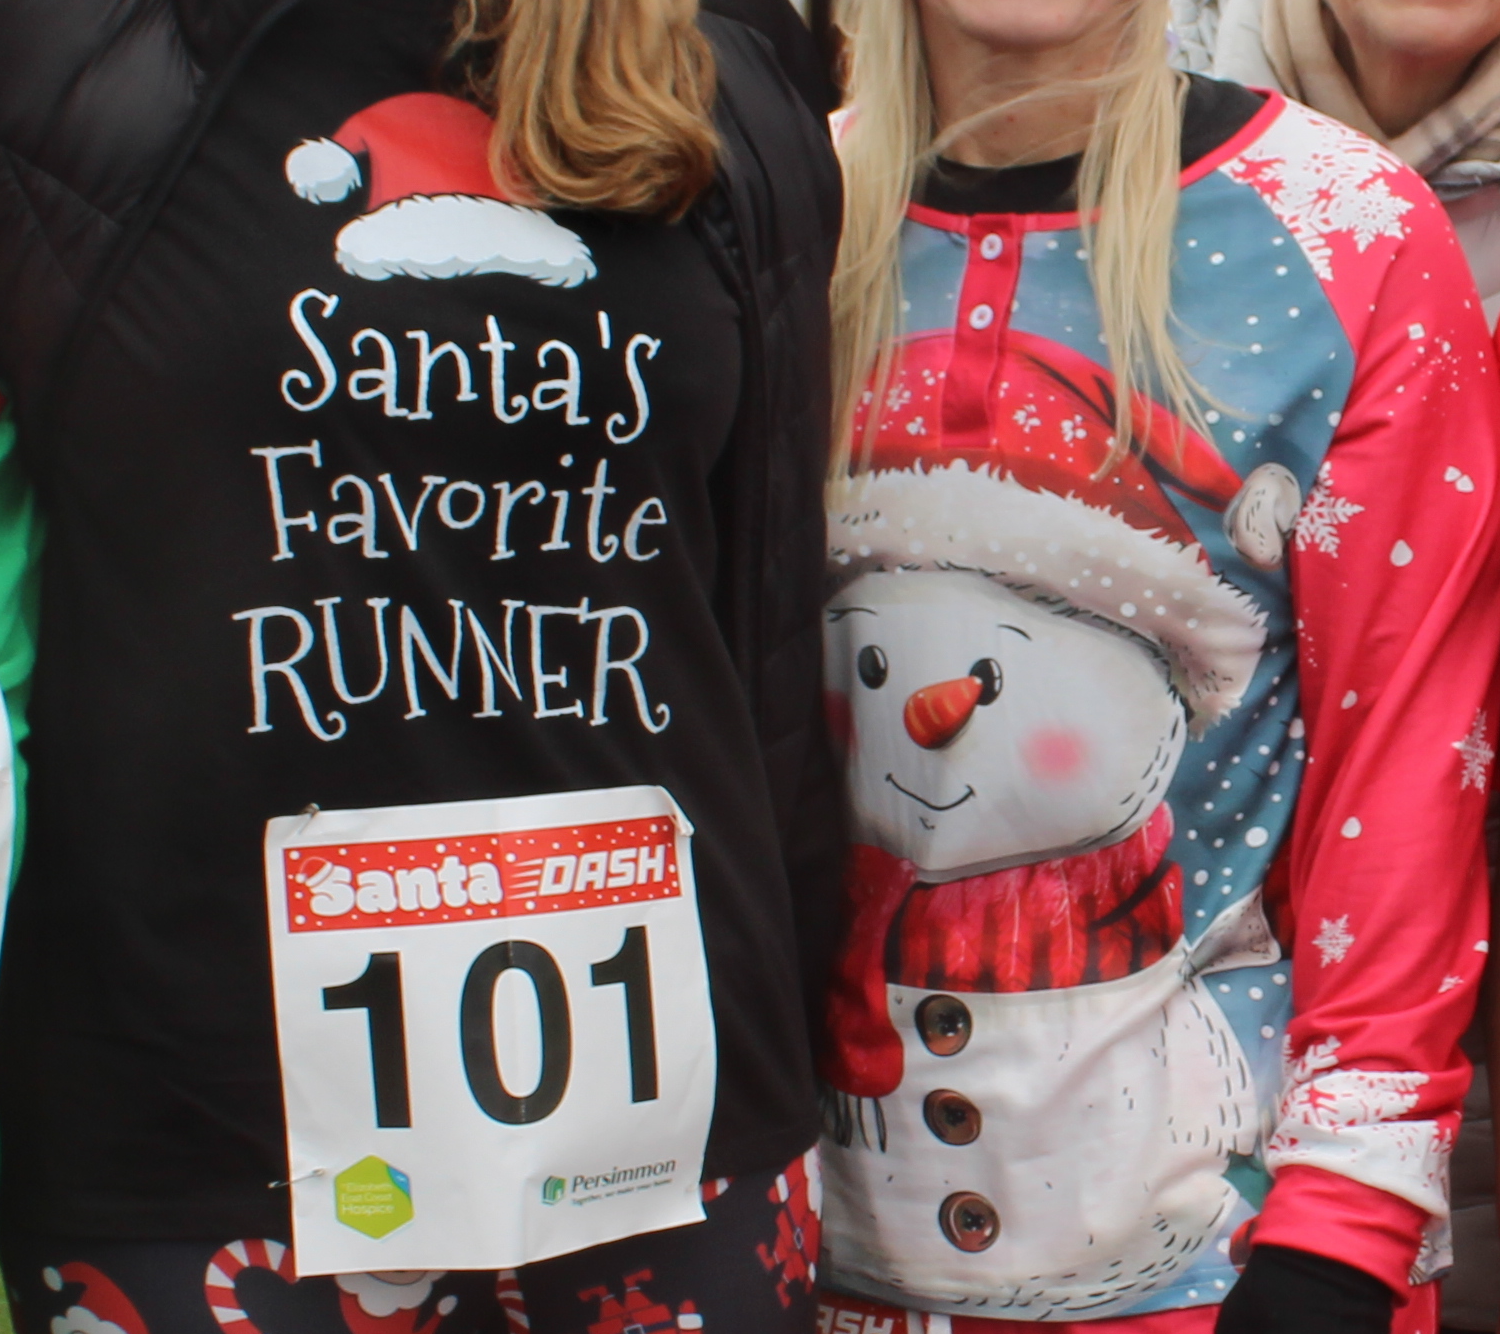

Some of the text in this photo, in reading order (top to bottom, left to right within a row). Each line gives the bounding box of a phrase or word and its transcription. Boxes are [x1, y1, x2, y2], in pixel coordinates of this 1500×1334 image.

[281, 288, 661, 445] Santa's
[250, 439, 668, 563] Favorite
[232, 596, 671, 742] RUNNER
[308, 844, 668, 917] Santa DASH
[321, 924, 659, 1129] 101
[571, 1159, 677, 1193] Persimmon
